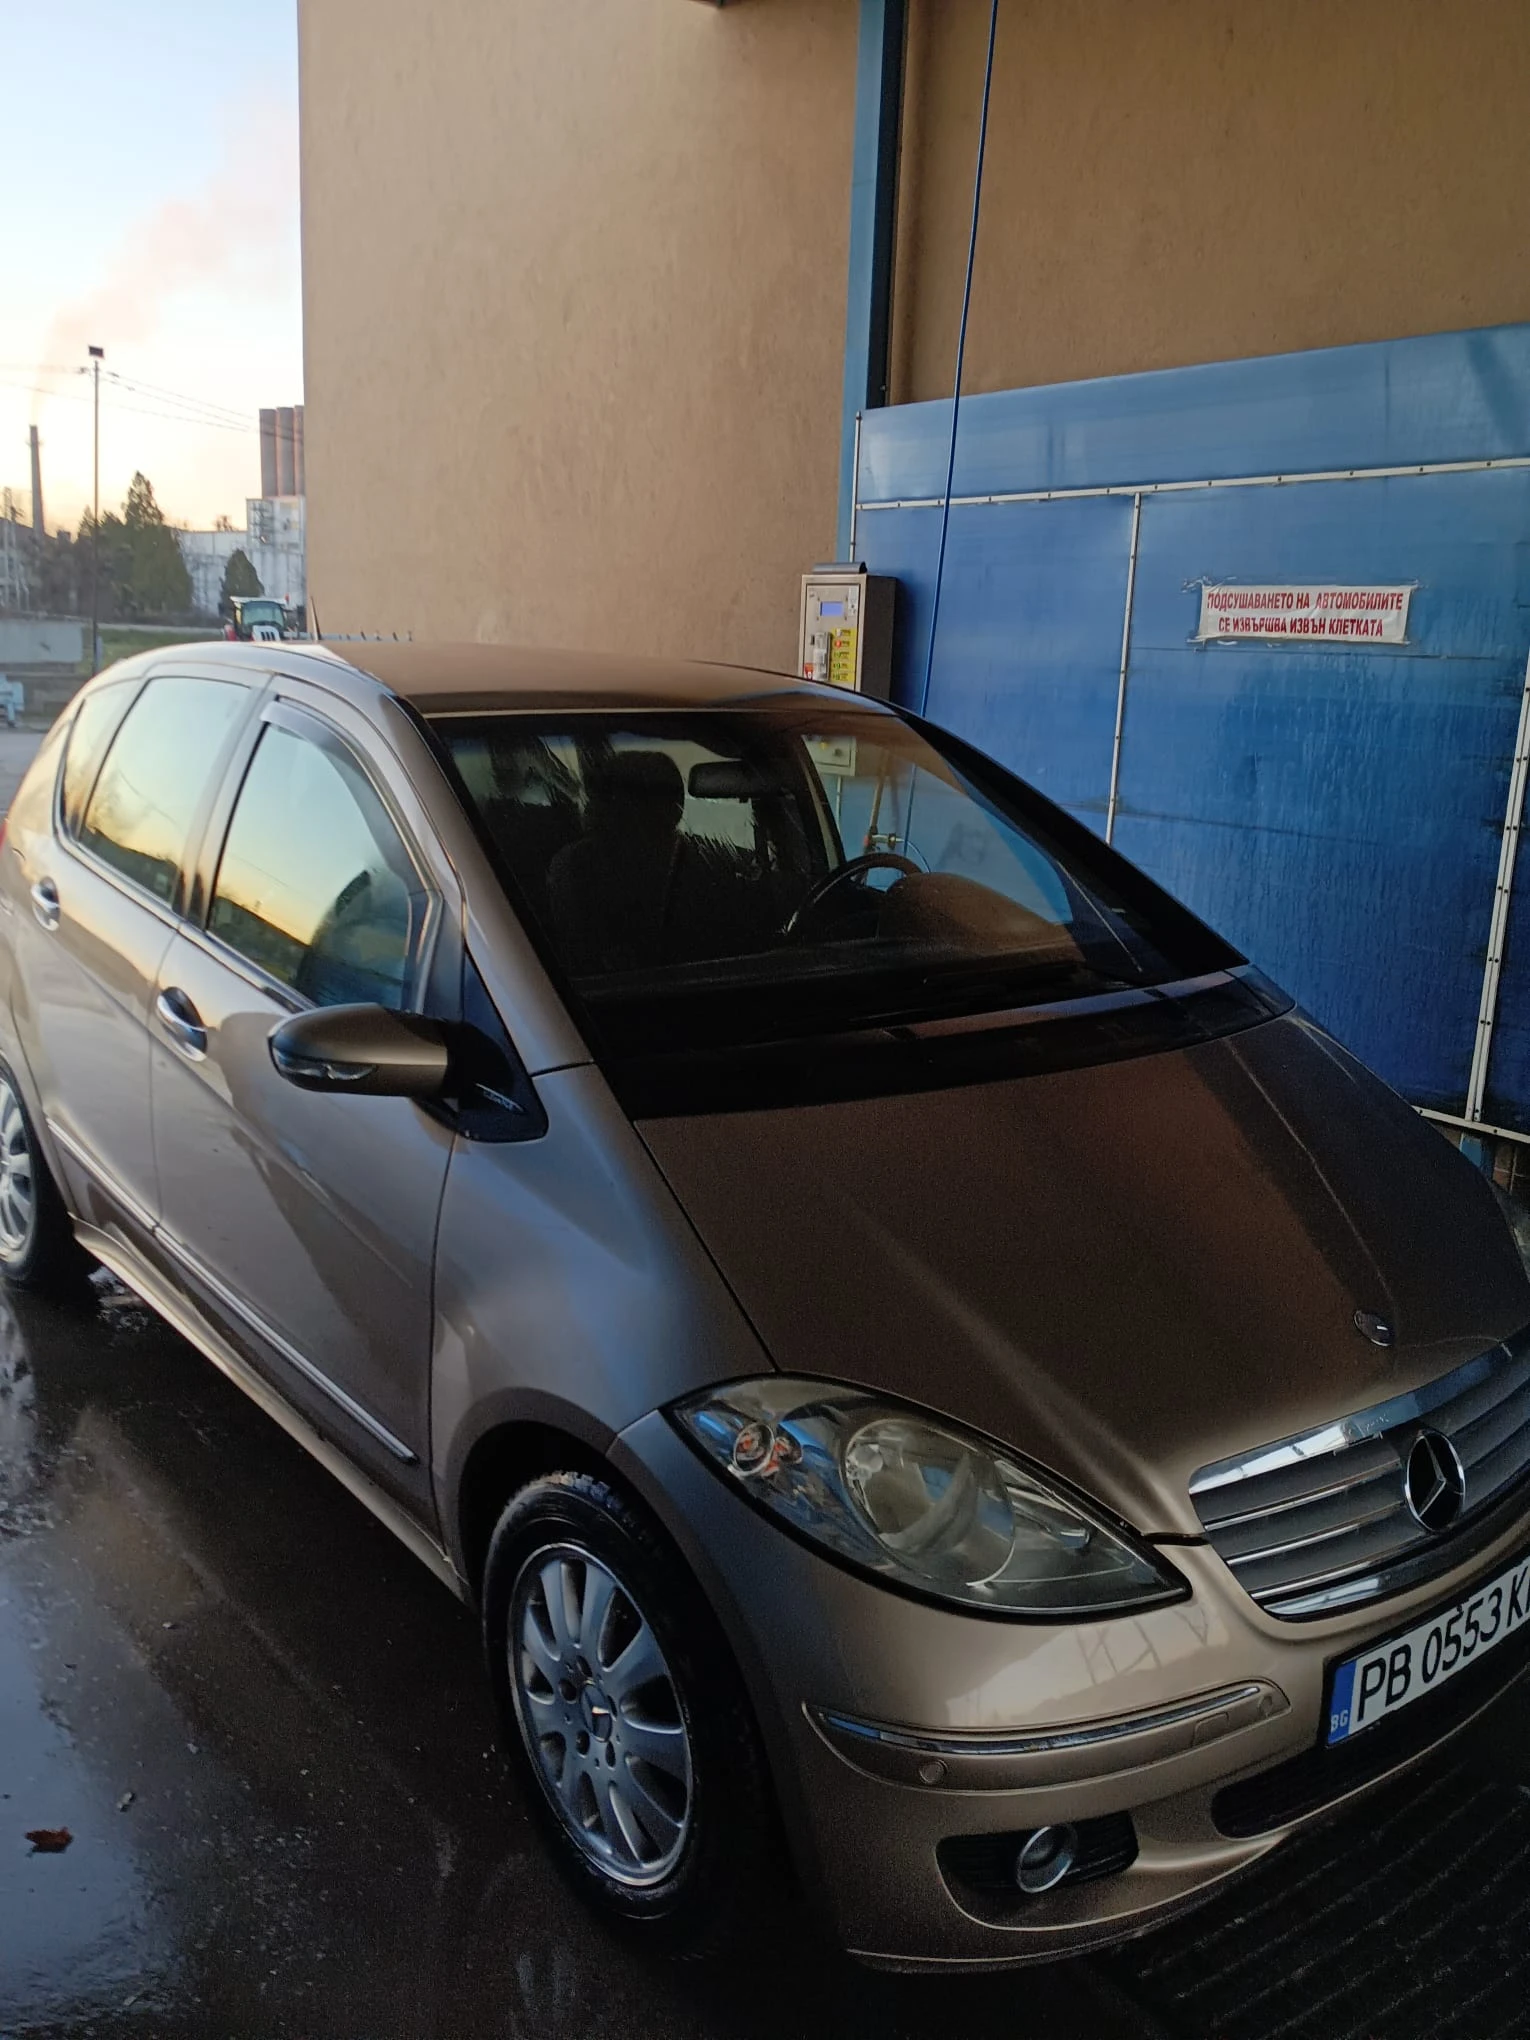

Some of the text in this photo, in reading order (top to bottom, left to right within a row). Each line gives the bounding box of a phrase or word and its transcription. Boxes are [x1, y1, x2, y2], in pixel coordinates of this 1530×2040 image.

[1207, 592, 1404, 612] ПОДСУШАВАНЕТО НА АВТОМОБИЛИТЕ
[1218, 617, 1384, 636] СЕ ИЗВЪРШВА ИЗВЪН КЛЕТКАТА
[1357, 1644, 1412, 1722] PB
[1422, 1587, 1503, 1684] 0553
[1330, 1709, 1349, 1731] BG
